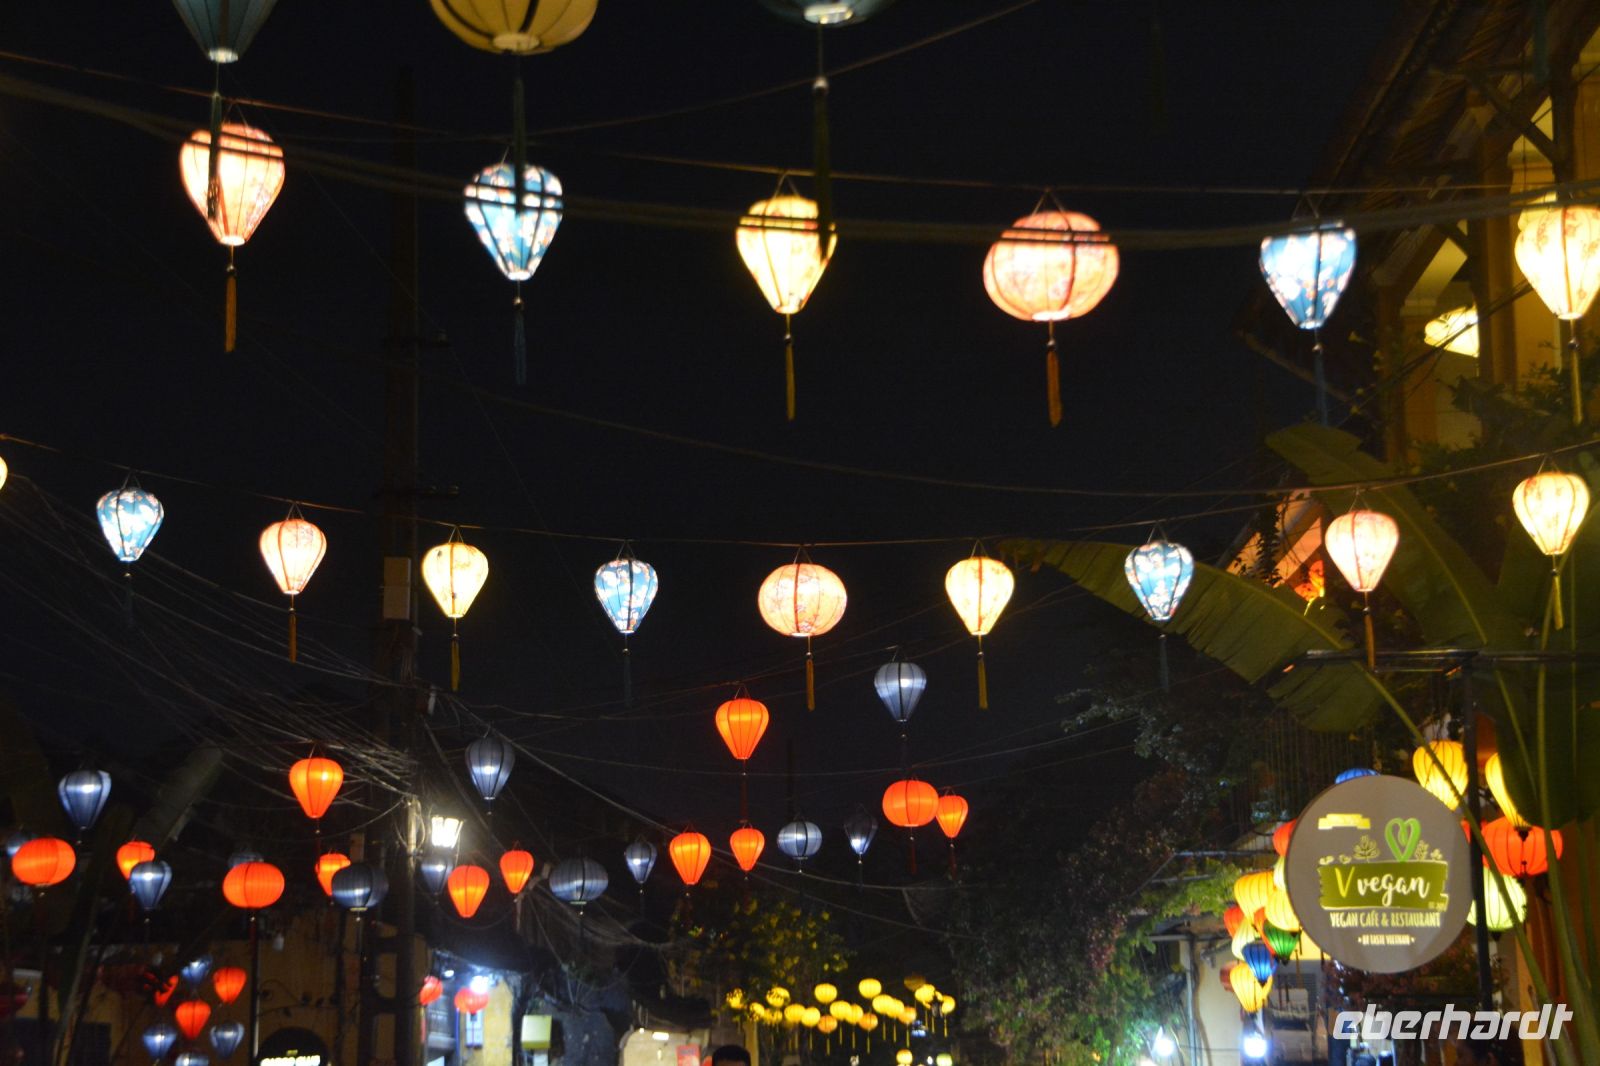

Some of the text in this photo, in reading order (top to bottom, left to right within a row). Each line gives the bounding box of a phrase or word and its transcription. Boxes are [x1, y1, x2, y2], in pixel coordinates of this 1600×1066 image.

[1335, 867, 1430, 907] V vegan
[1330, 912, 1358, 928] VEGAN
[1391, 912, 1440, 928] RESTAURANT
